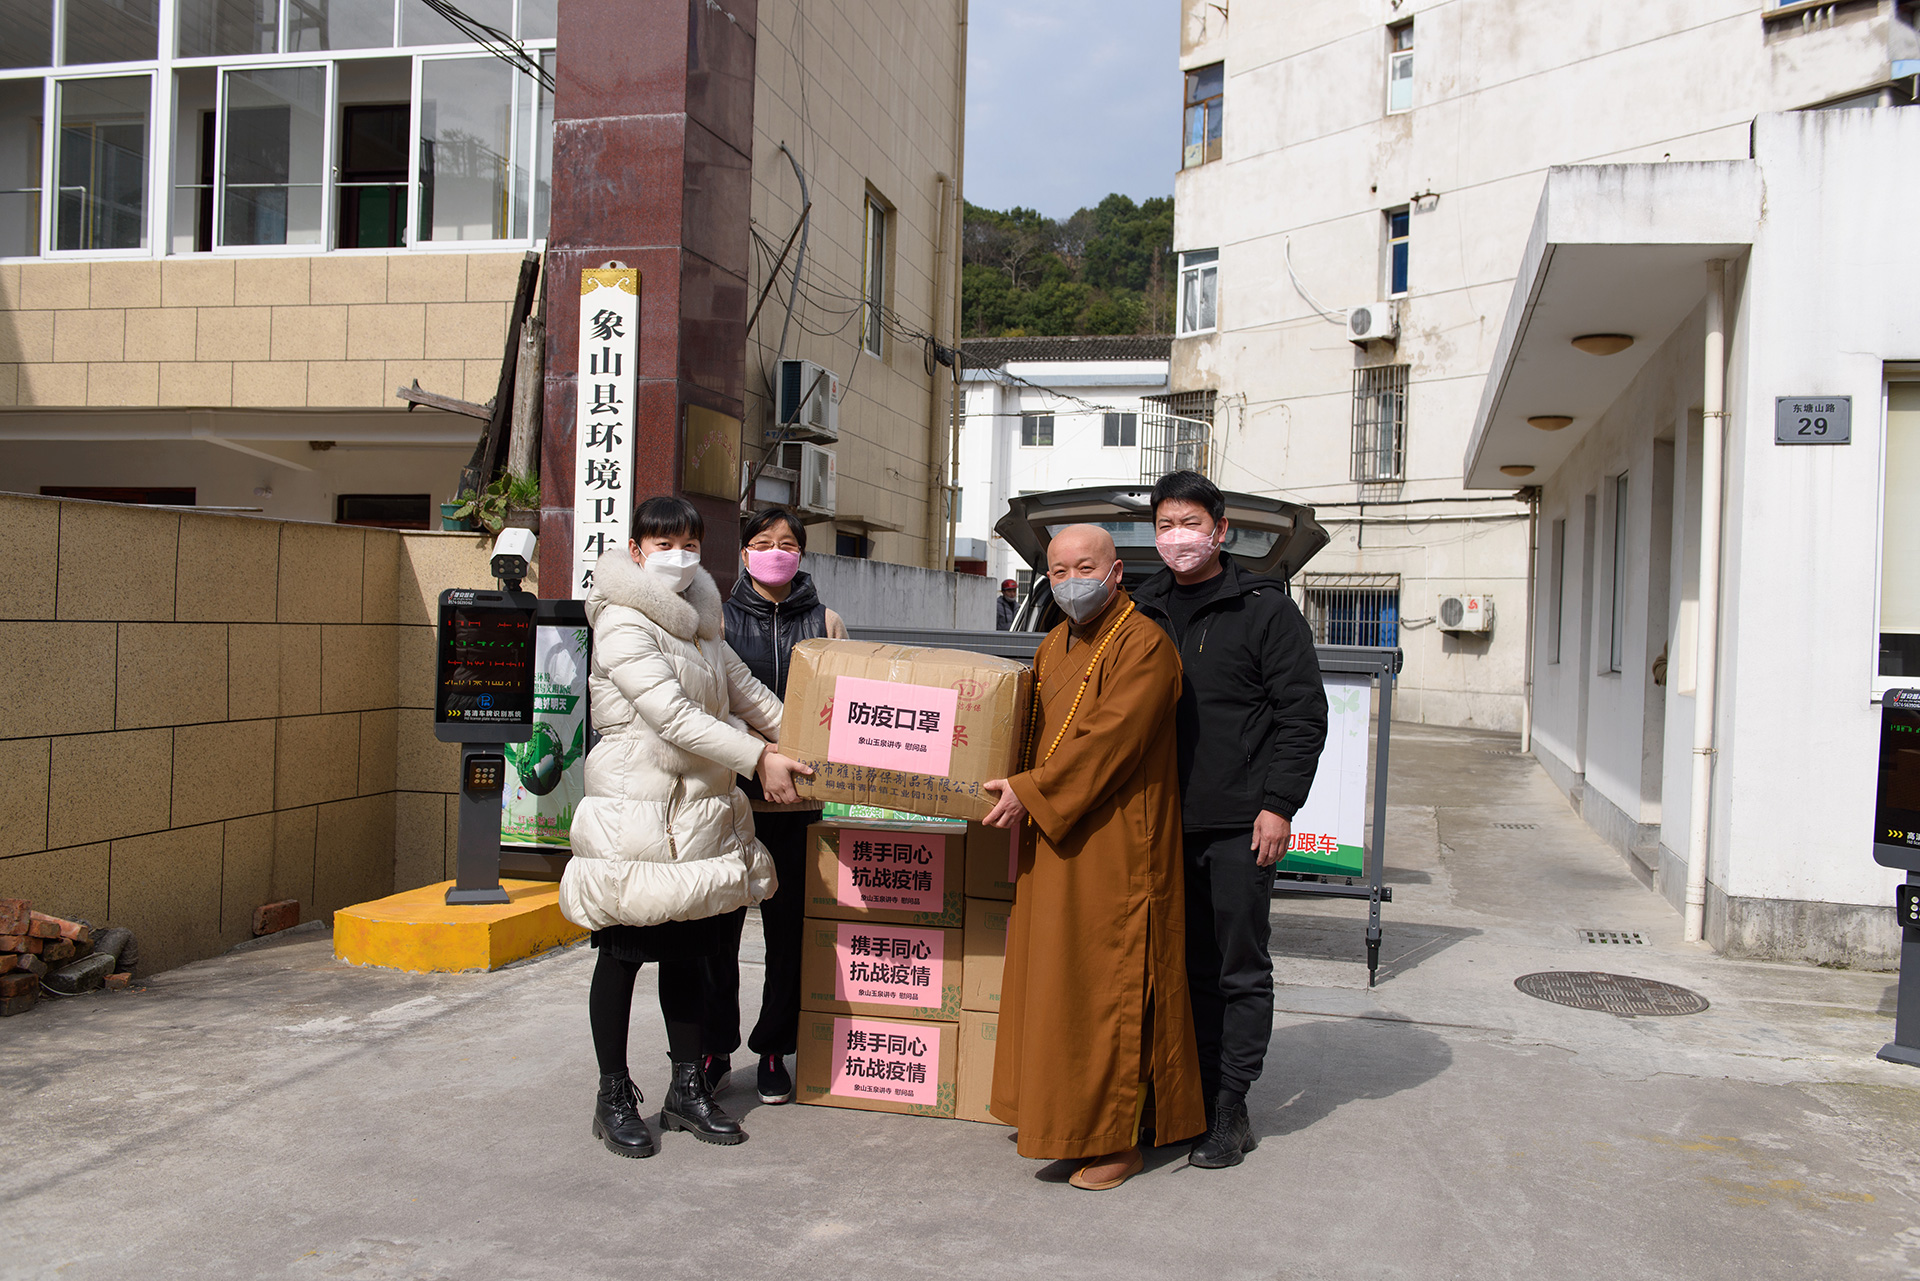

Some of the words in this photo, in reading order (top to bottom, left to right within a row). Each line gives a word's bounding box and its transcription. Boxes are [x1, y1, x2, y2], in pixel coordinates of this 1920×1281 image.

[1793, 403, 1836, 413] 东塘山路
[1798, 418, 1828, 435] 29
[581, 309, 625, 588] 象山县环境卫生
[958, 684, 977, 697] YJ
[534, 697, 567, 710] 美好明天
[464, 710, 521, 718] 高清车牌识别系统
[848, 702, 940, 733] 防疫口罩
[858, 737, 901, 749] 象山玉泉讲寺
[905, 743, 927, 753] 慰问品
[853, 841, 933, 865] 携手同心
[852, 867, 932, 891] 抗战疫情
[861, 894, 898, 903] 象山玉泉讲寺
[901, 897, 920, 905] 慰问品
[851, 935, 931, 959] 携手同心
[850, 961, 930, 987] 抗战疫情
[858, 989, 896, 999] 象山玉泉讲寺
[899, 992, 919, 1000] 慰问品
[847, 1030, 927, 1057] 携手同心
[846, 1056, 926, 1084] 抗战疫情
[854, 1084, 892, 1095] 象山玉泉讲寺
[895, 1088, 914, 1097] 慰问品
